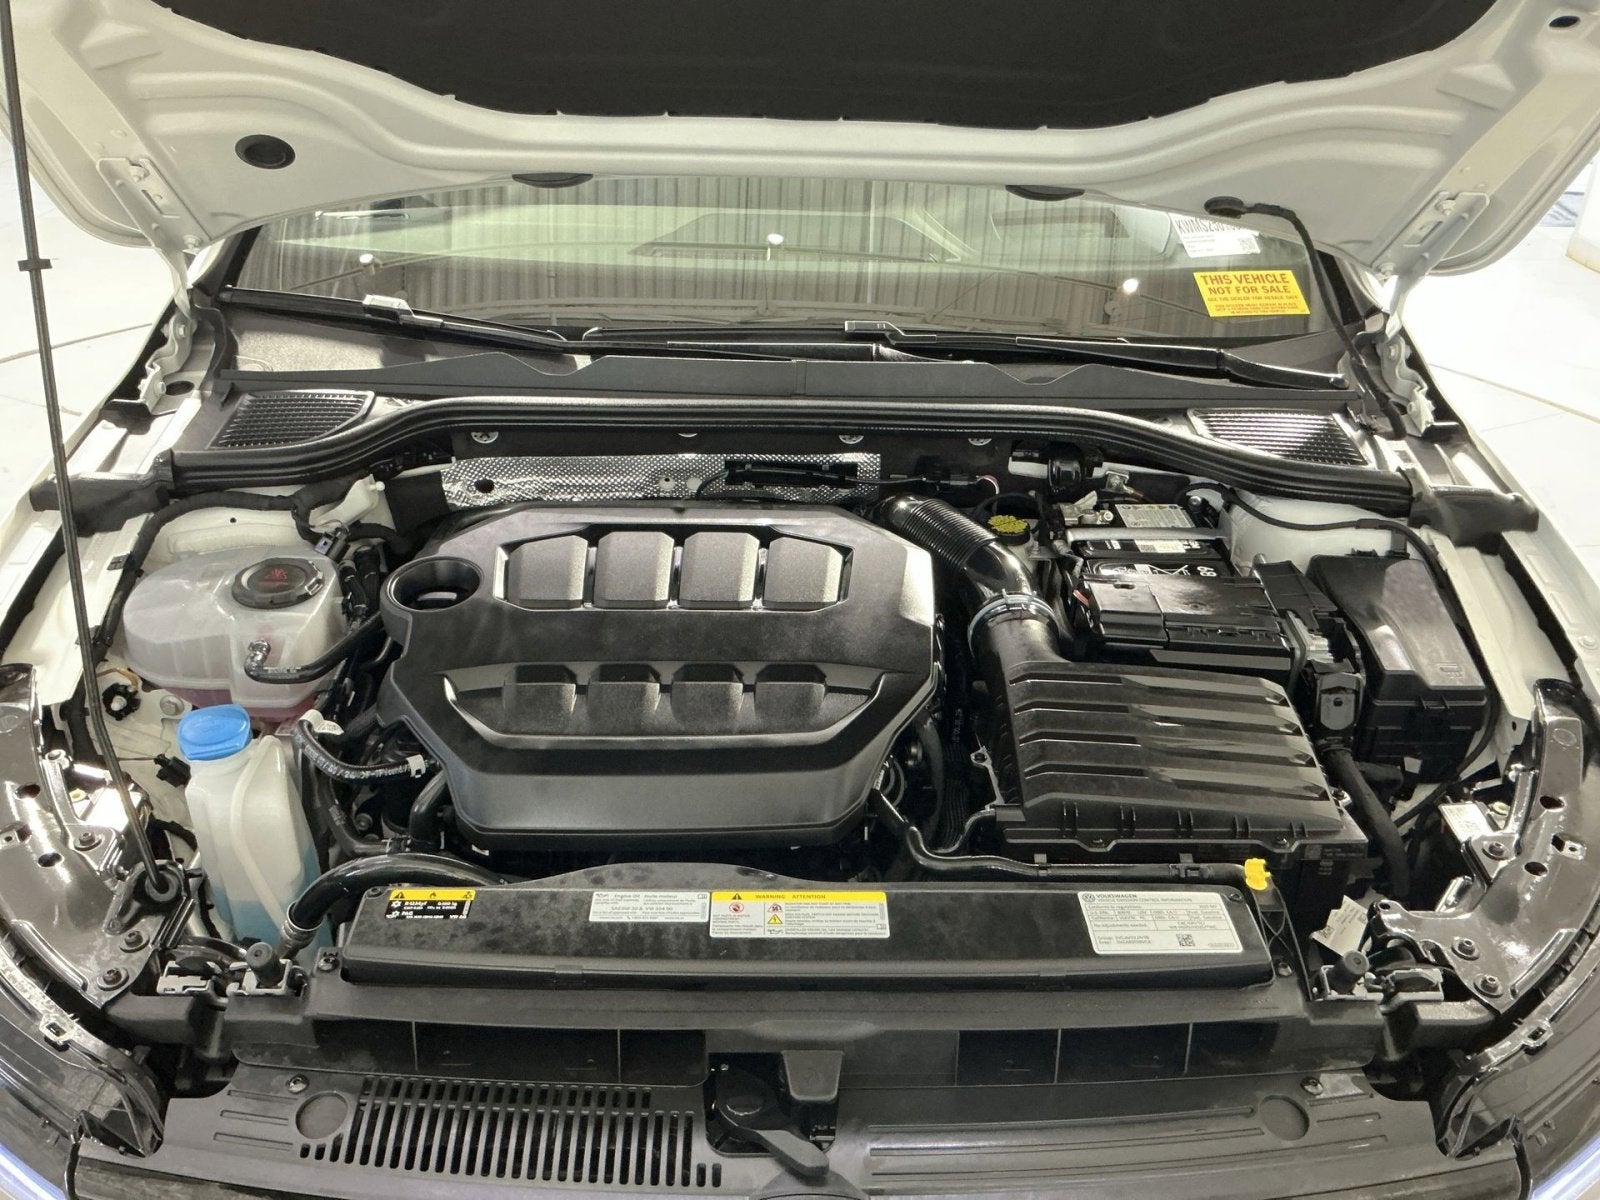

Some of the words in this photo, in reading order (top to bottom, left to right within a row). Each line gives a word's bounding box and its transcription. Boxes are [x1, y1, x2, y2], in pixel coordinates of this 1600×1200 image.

[1200, 275, 1233, 286] THIS
[1234, 273, 1290, 285] VEHICLE
[1208, 287, 1231, 295] NOT
[1236, 286, 1260, 294] FOR
[1262, 285, 1291, 294] SALE
